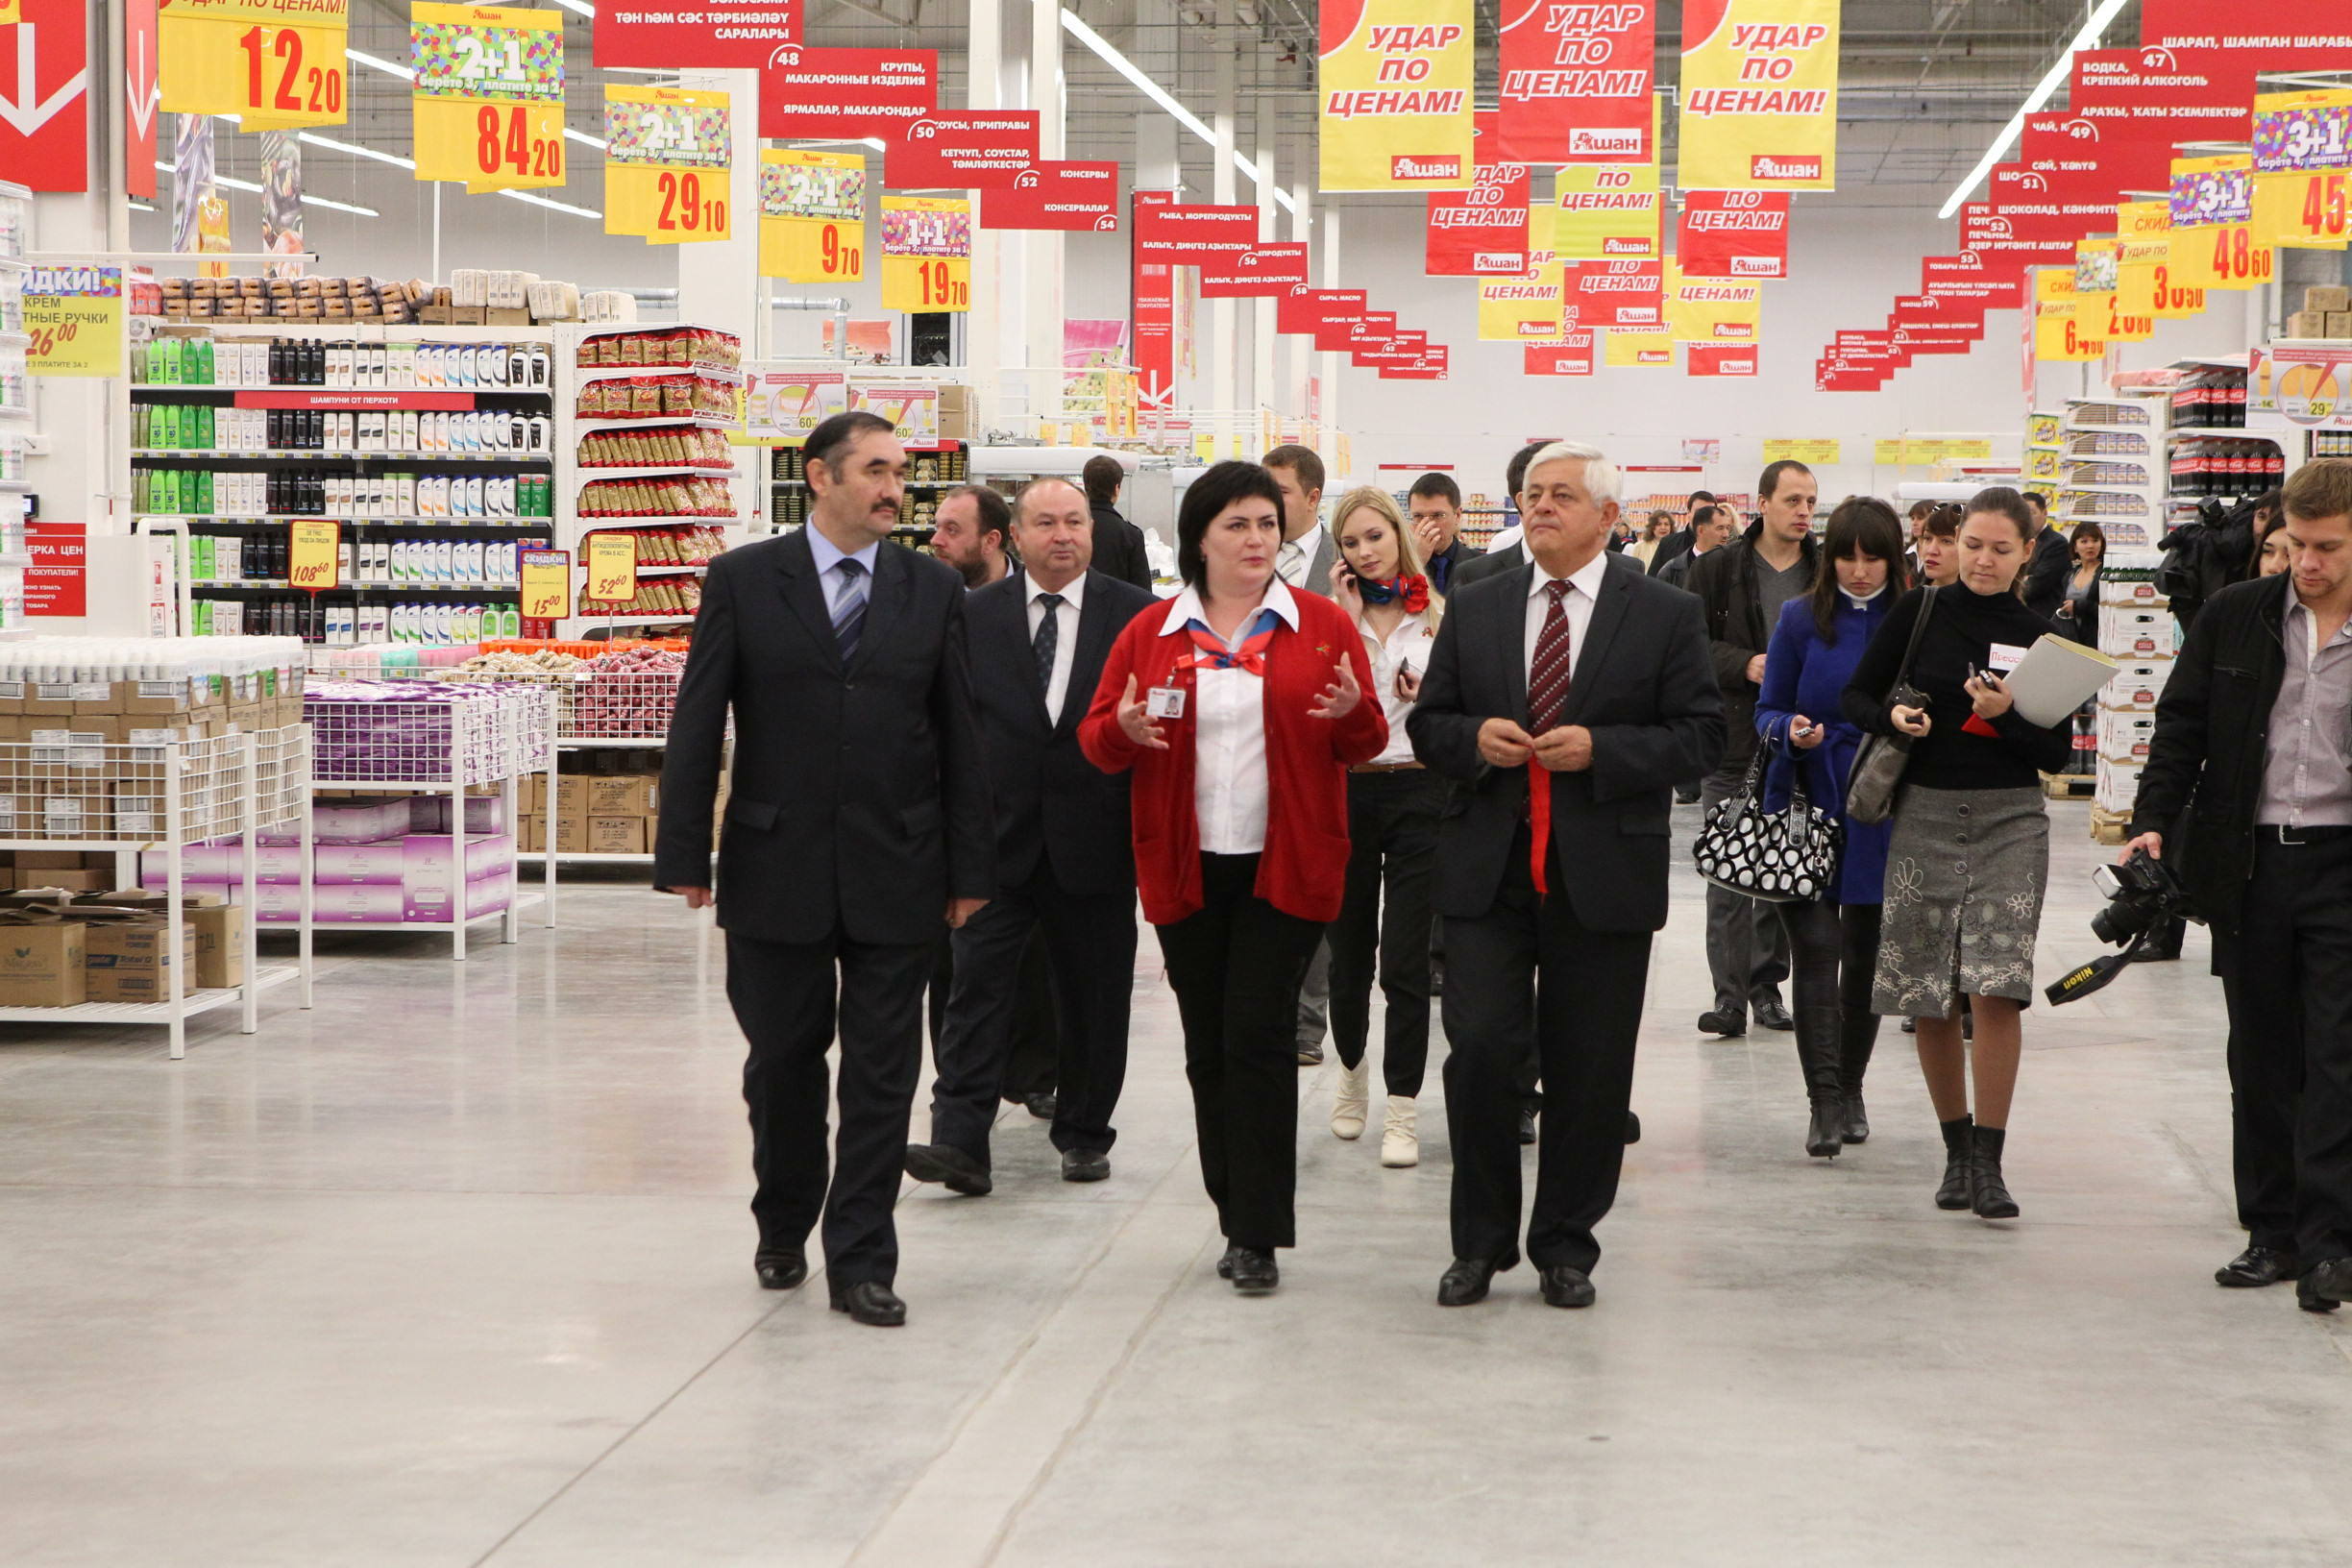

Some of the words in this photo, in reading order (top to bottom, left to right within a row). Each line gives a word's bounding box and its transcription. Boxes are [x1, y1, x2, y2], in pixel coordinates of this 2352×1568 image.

[1545, 5, 1645, 36] УДАР
[715, 28, 789, 39] САРАЛАРЫ
[1367, 26, 1461, 53] УДАР
[1732, 26, 1825, 51] УДАР
[2163, 37, 2219, 49] ШАРАП,
[2222, 37, 2291, 48] ШАМПАН
[1555, 37, 1612, 64] ПО
[455, 37, 527, 81] 2+1
[777, 53, 799, 65] 48
[2143, 54, 2166, 67] 47
[881, 62, 925, 73] КРУПЫ,
[1379, 60, 1430, 81] ПО
[1741, 59, 1793, 80] ПО
[2082, 62, 2129, 74] ВОДКА,
[786, 74, 869, 85] МАКАРОННЫЕ
[871, 75, 925, 86] ИЗДЕЛИЯ
[1502, 70, 1647, 101] ЦЕНАМ!
[2082, 74, 2140, 86] КРЕПКИЙ
[2143, 76, 2208, 86] АЛКОГОЛЬ
[1328, 91, 1463, 118] ЦЕНАМ!
[1688, 90, 1826, 115] ЦЕНАМ!
[784, 105, 841, 115] ЯРМАЛАР,
[844, 106, 926, 116] МАКАРОНДАР
[641, 113, 699, 151] 2+1
[916, 127, 935, 138] 50
[972, 121, 1030, 131] ПРИПРАВЫ
[2032, 122, 2058, 133] ЧАЙ,
[2070, 128, 2091, 138] 49
[2286, 119, 2343, 159] 3+1
[1574, 133, 1637, 151] Ашан
[941, 149, 982, 159] КЕТЧУП,
[984, 149, 1030, 159] СОУСТАР,
[1060, 170, 1109, 179] КОНСЕРВЫ
[1395, 159, 1458, 177] Ашан
[1754, 159, 1819, 177] Ашан
[1021, 177, 1038, 187] 52
[1596, 171, 1630, 187] ПО
[2022, 179, 2038, 189] 51
[790, 173, 839, 207] 2+1
[1466, 186, 1505, 205] ПО
[2197, 179, 2246, 212] 3+1
[1561, 193, 1653, 210] ЦЕНАМ!
[1724, 191, 1763, 208] ПО
[1044, 204, 1109, 212] КОНСЕРВАЛАР
[1998, 205, 2059, 215] ШОКОЛАД,
[1159, 212, 1184, 221] РЫБА,
[1186, 212, 1252, 221] МОРЕПРОДУКТЫ
[1431, 208, 1527, 229] ЦЕНАМ!
[1688, 210, 1785, 232] ЦЕНАМ!
[907, 218, 946, 246] 1+1
[1100, 221, 1115, 230] 54
[1990, 222, 2005, 232] 53
[1605, 239, 1650, 254] Ашан
[2038, 241, 2073, 250] АШТАР
[1244, 257, 1258, 265] 56
[1477, 256, 1520, 269] Ашан
[1961, 255, 1974, 263] 55
[1608, 260, 1641, 273] ПО
[1733, 259, 1777, 273] Ашан
[1580, 277, 1659, 293] ЦЕНАМ!
[1482, 285, 1558, 301] ЦЕНАМ!
[1680, 287, 1755, 302] ЦЕНАМ!
[24, 298, 61, 307] КРЕМ
[65, 313, 109, 324] РУЧКИ
[1520, 323, 1555, 333] Ашан
[1715, 325, 1752, 336] Ашан
[61, 545, 84, 556] ЦЕН
[2063, 967, 2094, 991] Nikon
